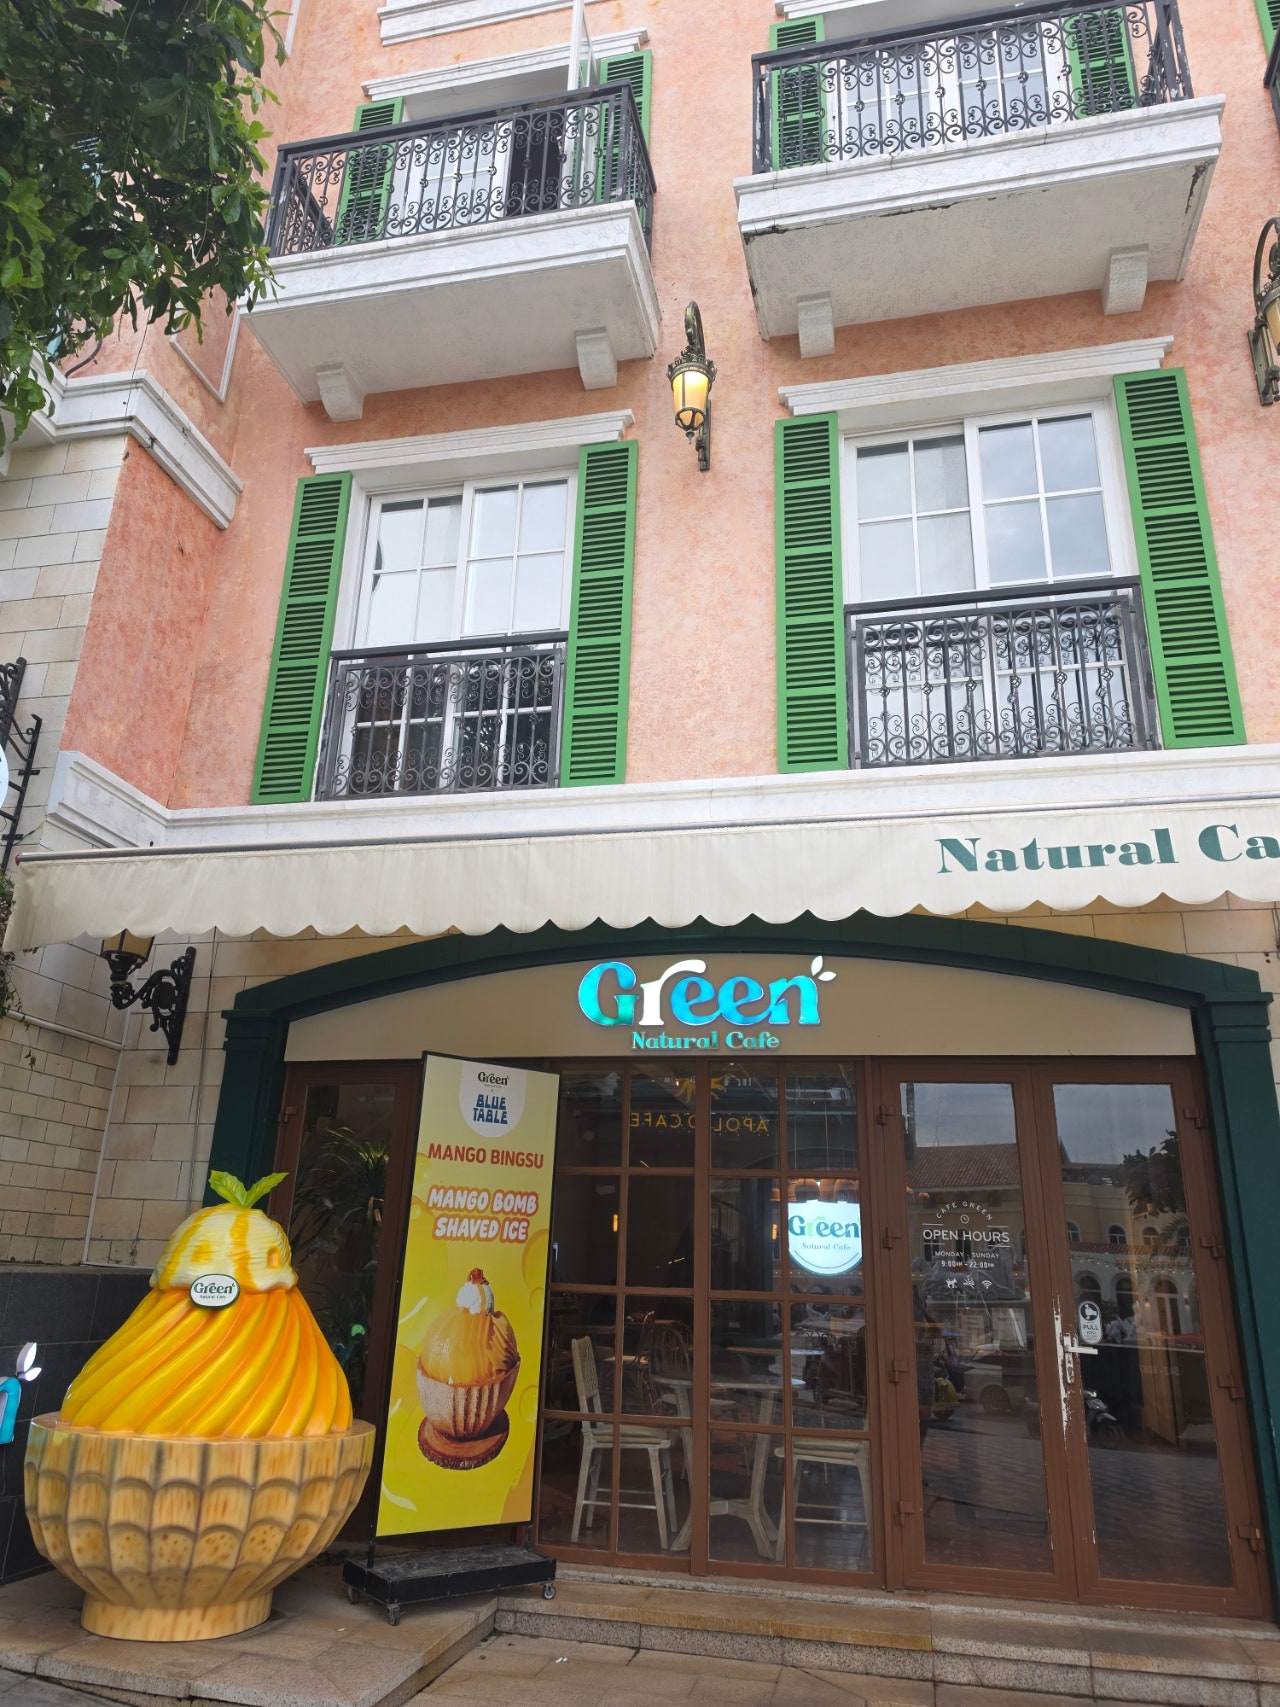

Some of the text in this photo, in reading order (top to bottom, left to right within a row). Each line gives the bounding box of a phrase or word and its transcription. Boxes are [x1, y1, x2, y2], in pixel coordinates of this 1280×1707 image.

[935, 824, 1280, 874] Natural Ca
[578, 958, 821, 1026] Green
[631, 1030, 780, 1049] Natural Cafe
[477, 1071, 508, 1086] Green
[475, 1093, 507, 1110] BLUE
[472, 1107, 508, 1125] TABLE
[427, 1143, 545, 1169] MANGO BINGSU
[427, 1187, 538, 1215] MANGO BOMB
[936, 1201, 993, 1221] CAFE GREEN
[434, 1216, 529, 1241] SHAVED ICE
[788, 1214, 860, 1238] Green
[922, 1229, 1010, 1243] OPEN HOURS
[935, 1250, 965, 1258] MONDAY
[193, 1282, 233, 1294] Green
